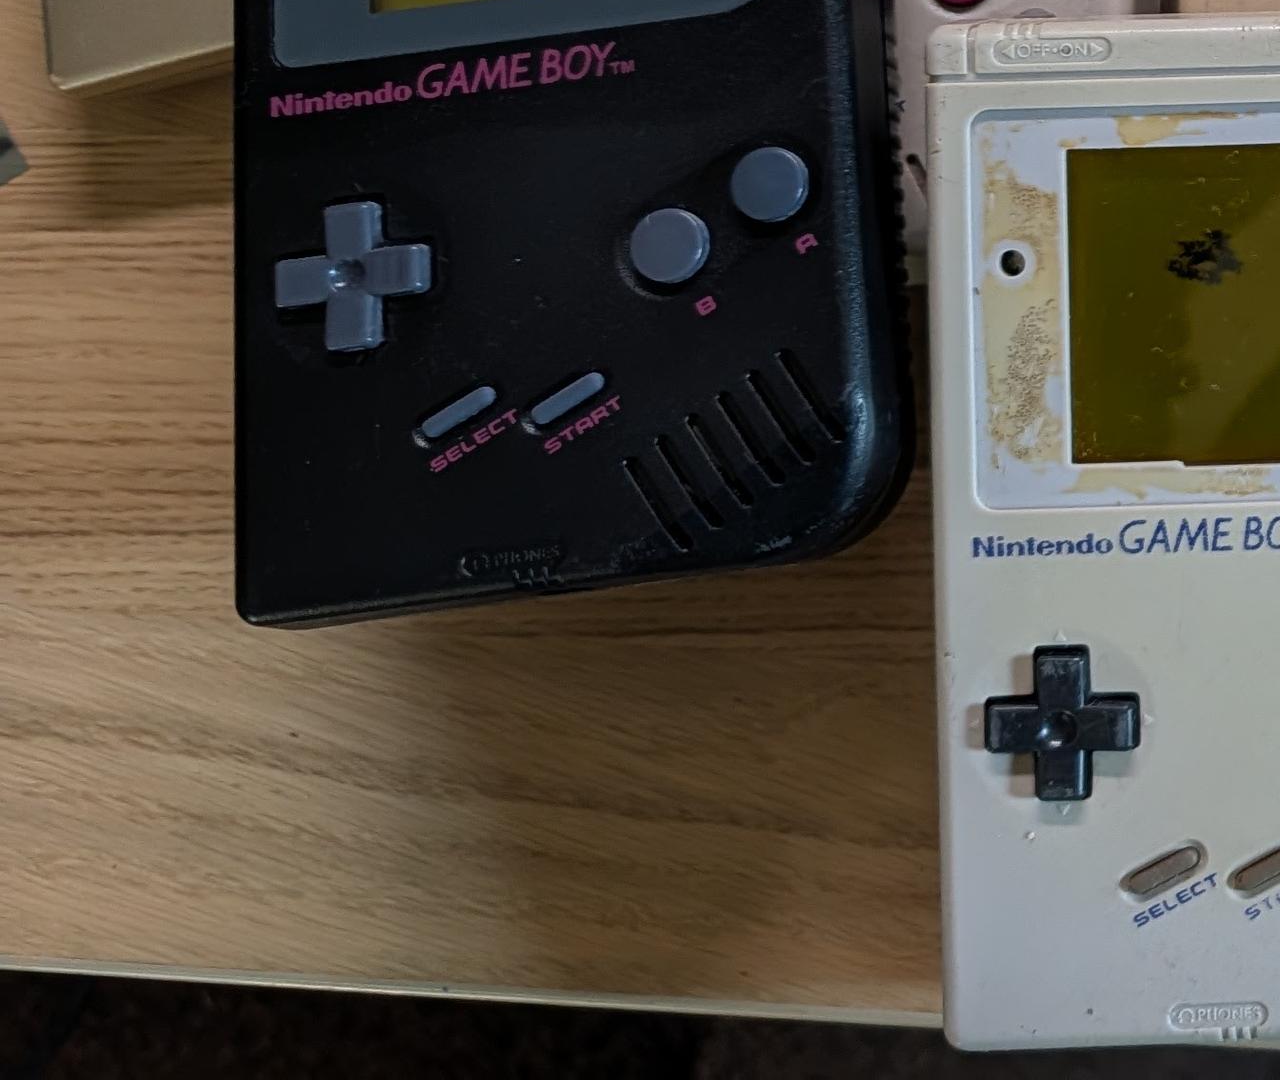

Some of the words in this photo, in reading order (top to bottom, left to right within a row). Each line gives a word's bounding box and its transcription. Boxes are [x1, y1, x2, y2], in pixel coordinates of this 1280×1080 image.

[269, 81, 412, 118] Nintendo
[416, 51, 531, 99] GAME
[538, 41, 617, 85] BOY
[429, 407, 519, 473] SELECT
[542, 394, 622, 455] START
[971, 532, 1114, 559] Nintendo
[1118, 516, 1233, 555] GAME
[1132, 871, 1220, 929] SELECT
